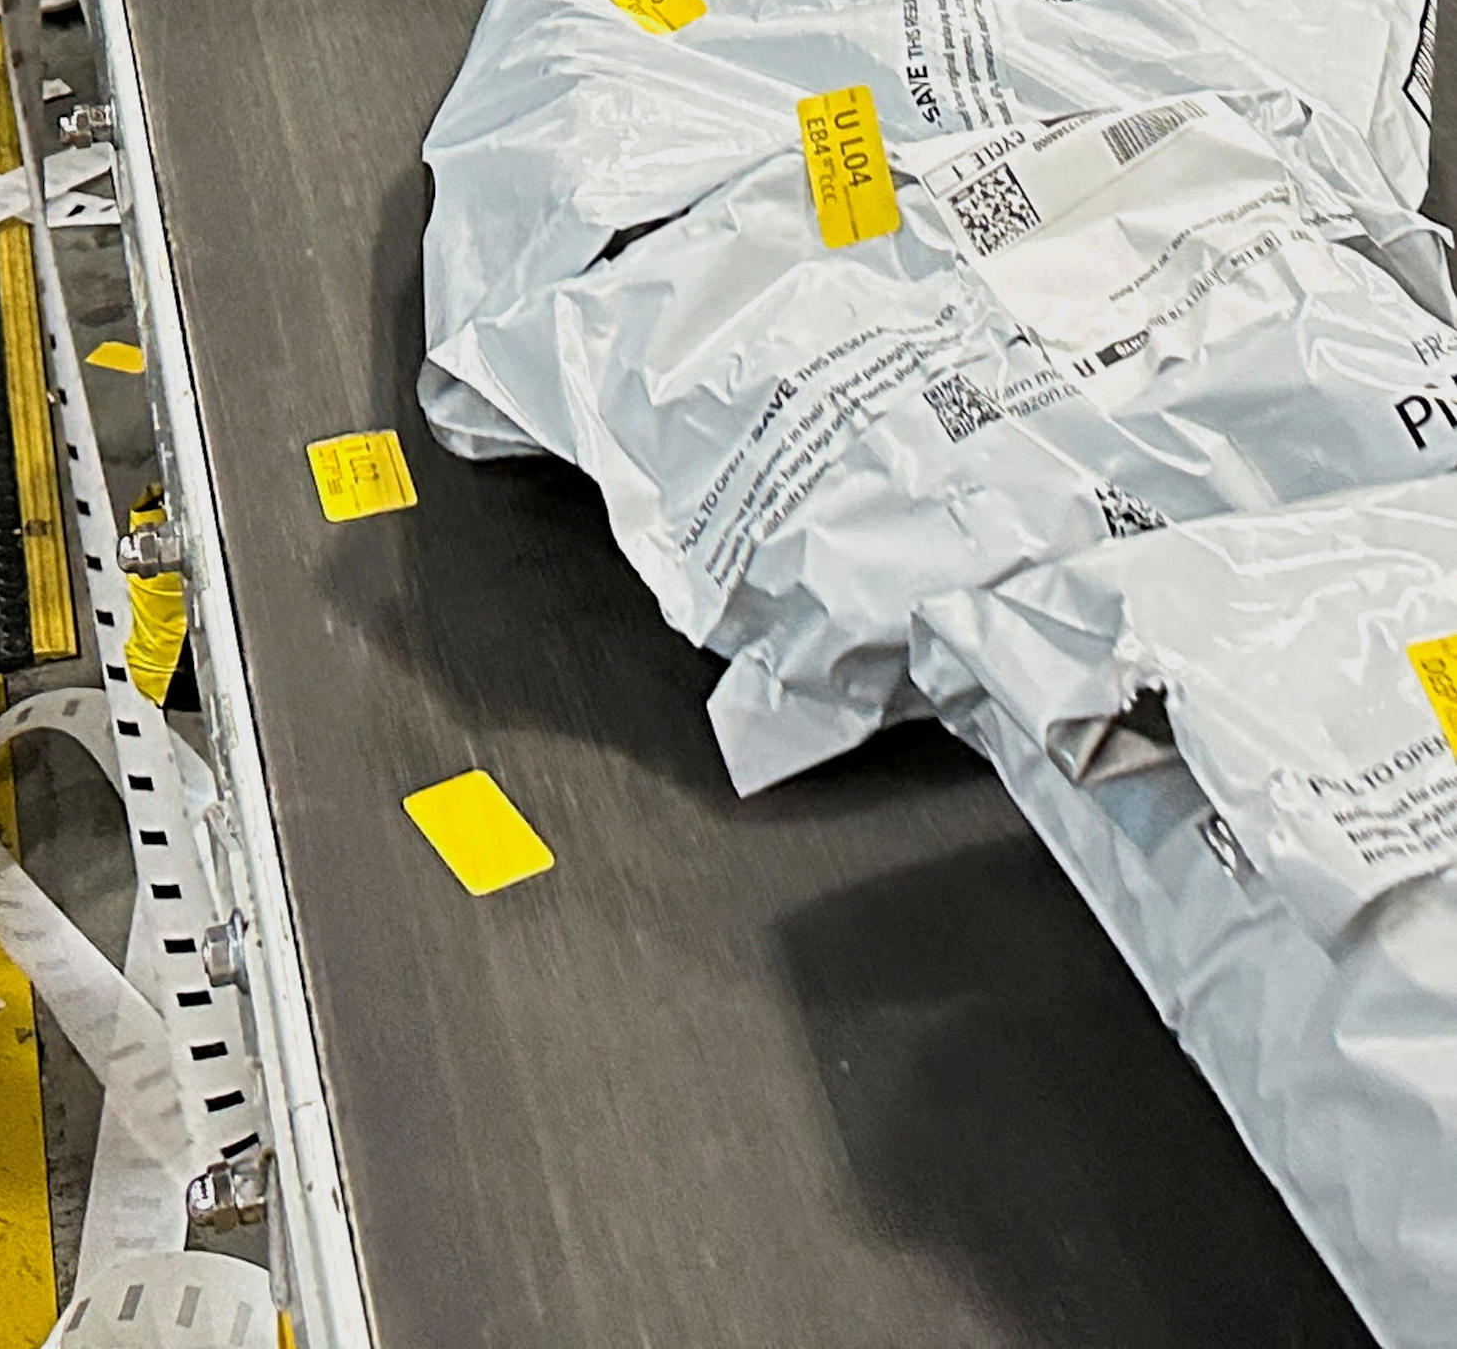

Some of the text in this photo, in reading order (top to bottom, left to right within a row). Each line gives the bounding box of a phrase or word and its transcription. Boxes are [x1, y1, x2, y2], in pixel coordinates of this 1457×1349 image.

[906, 64, 942, 124] SAVE
[806, 115, 832, 157] EB4
[833, 108, 874, 189] U L04
[973, 129, 1027, 171] CYCLE
